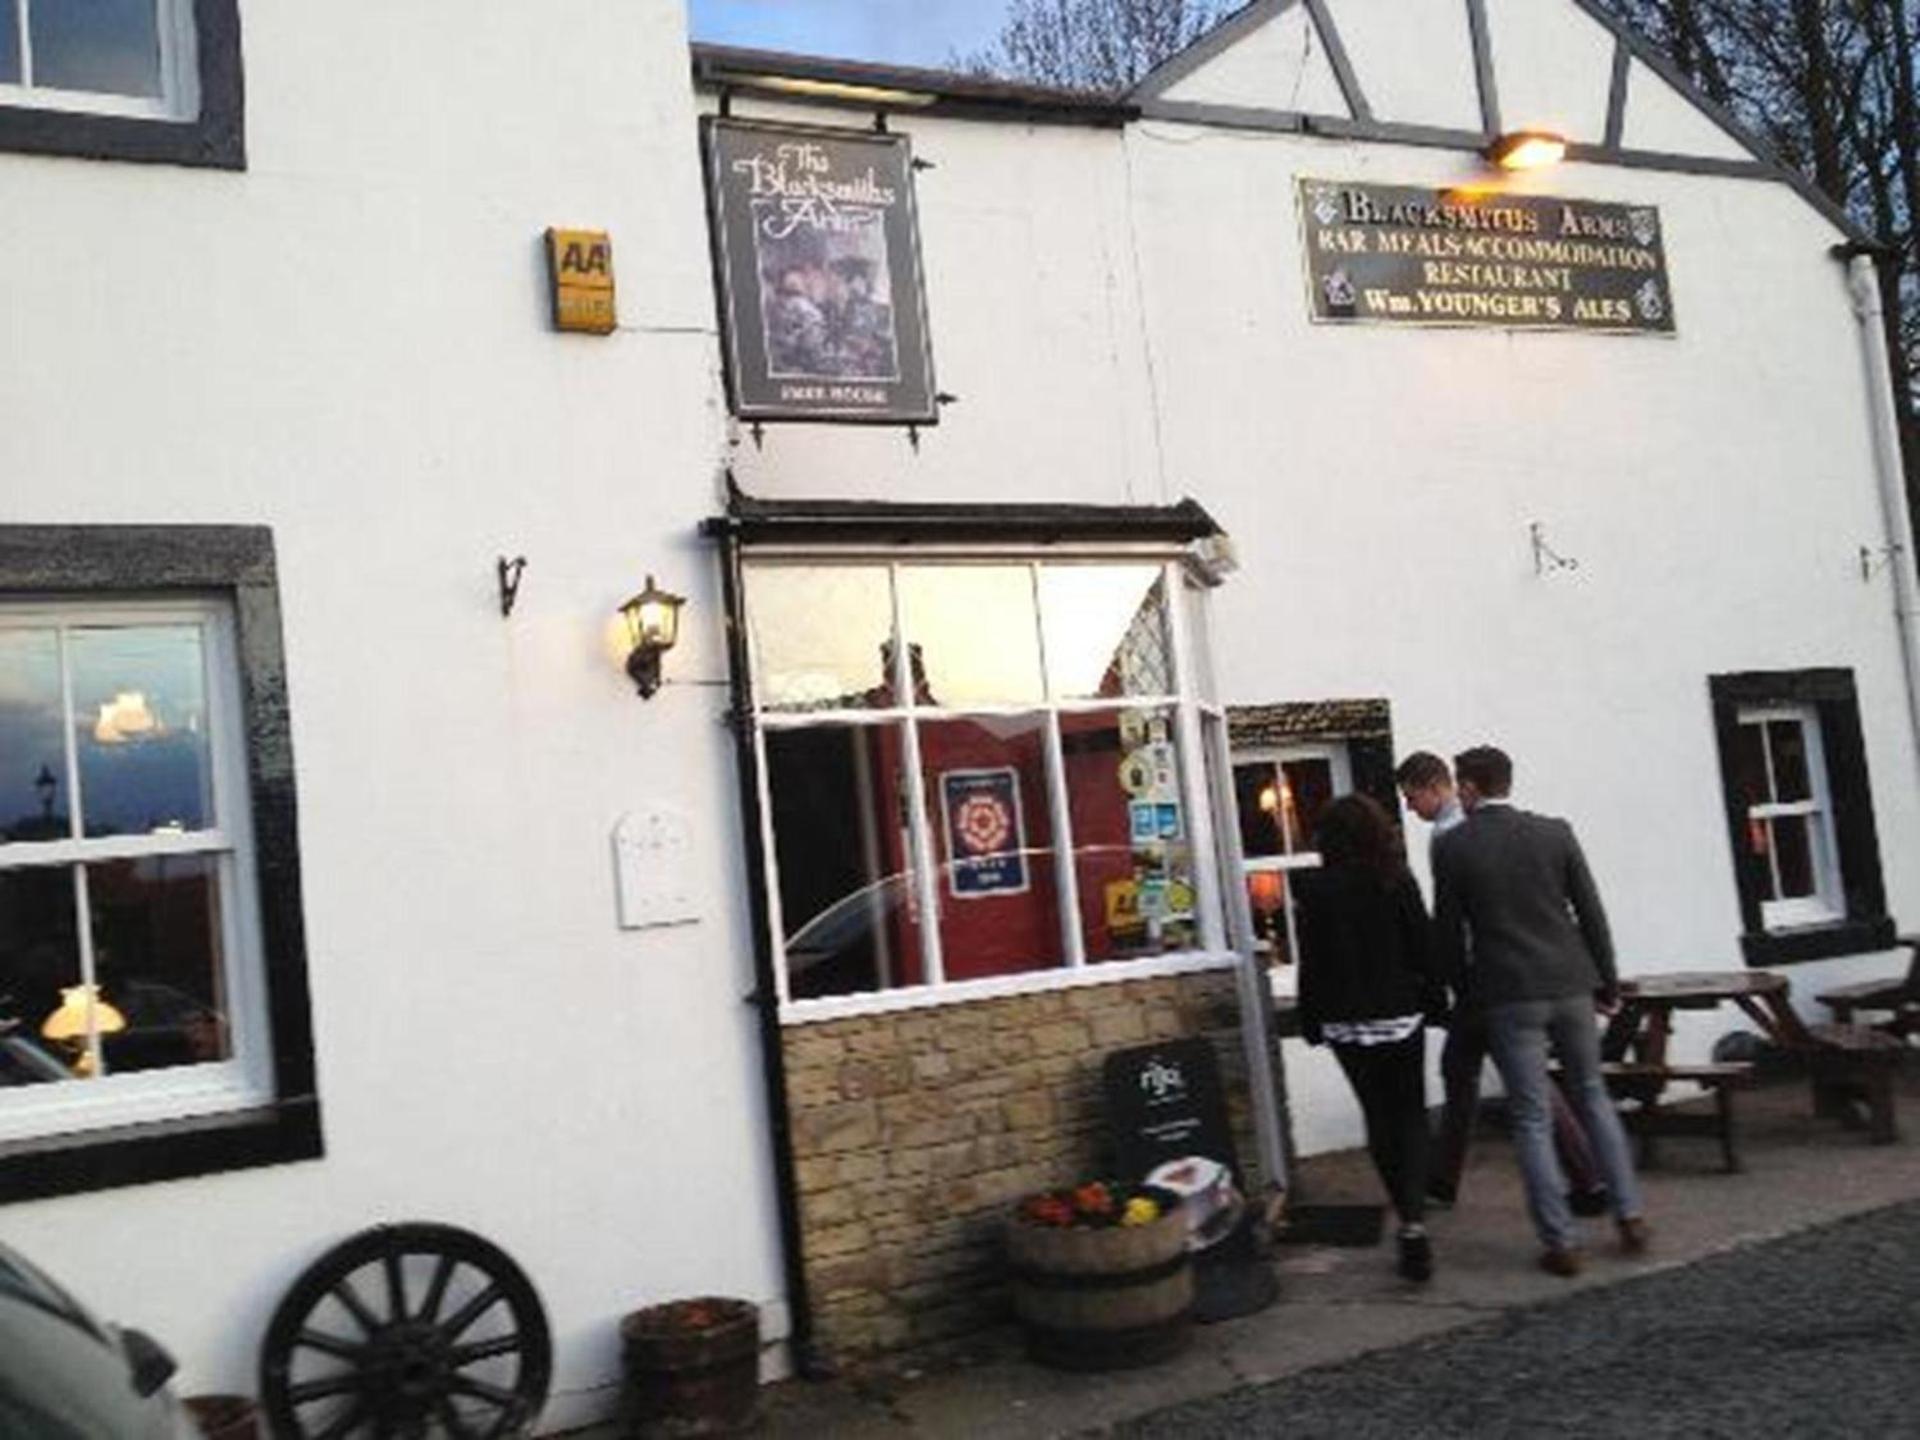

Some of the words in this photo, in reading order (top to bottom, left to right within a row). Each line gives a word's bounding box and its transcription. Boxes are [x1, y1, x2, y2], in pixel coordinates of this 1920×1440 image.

[778, 143, 829, 173] The
[1317, 230, 1367, 252] BAR
[562, 241, 611, 273] AA
[1424, 261, 1572, 290] RESTAURANT
[1573, 297, 1632, 321] ALES
